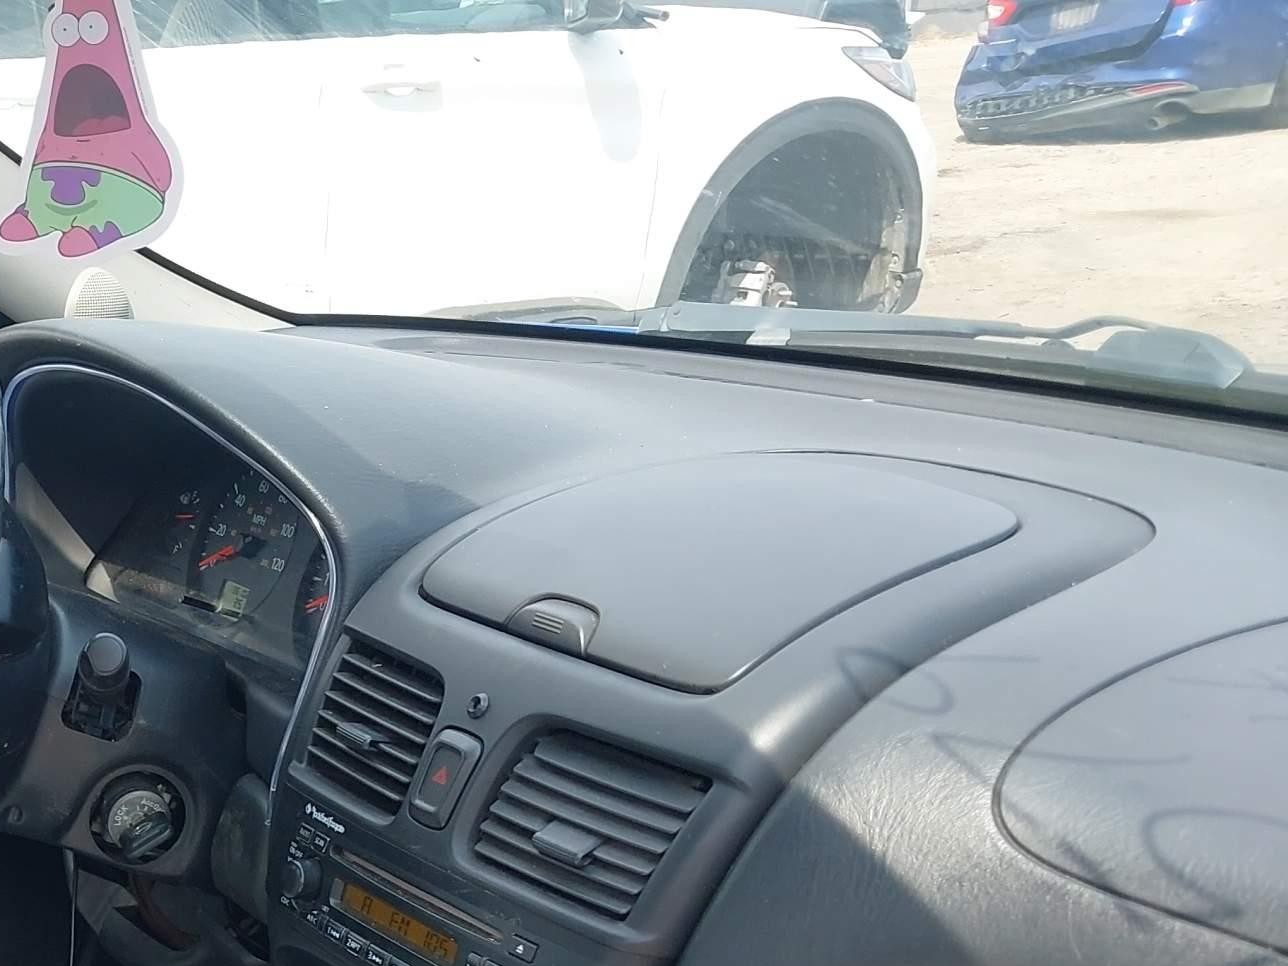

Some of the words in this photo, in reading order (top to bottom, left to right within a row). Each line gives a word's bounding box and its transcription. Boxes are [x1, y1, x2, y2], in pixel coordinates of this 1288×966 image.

[216, 523, 227, 536] 20
[280, 523, 295, 538] 100
[272, 557, 285, 572] 120
[114, 804, 129, 826] LOCK
